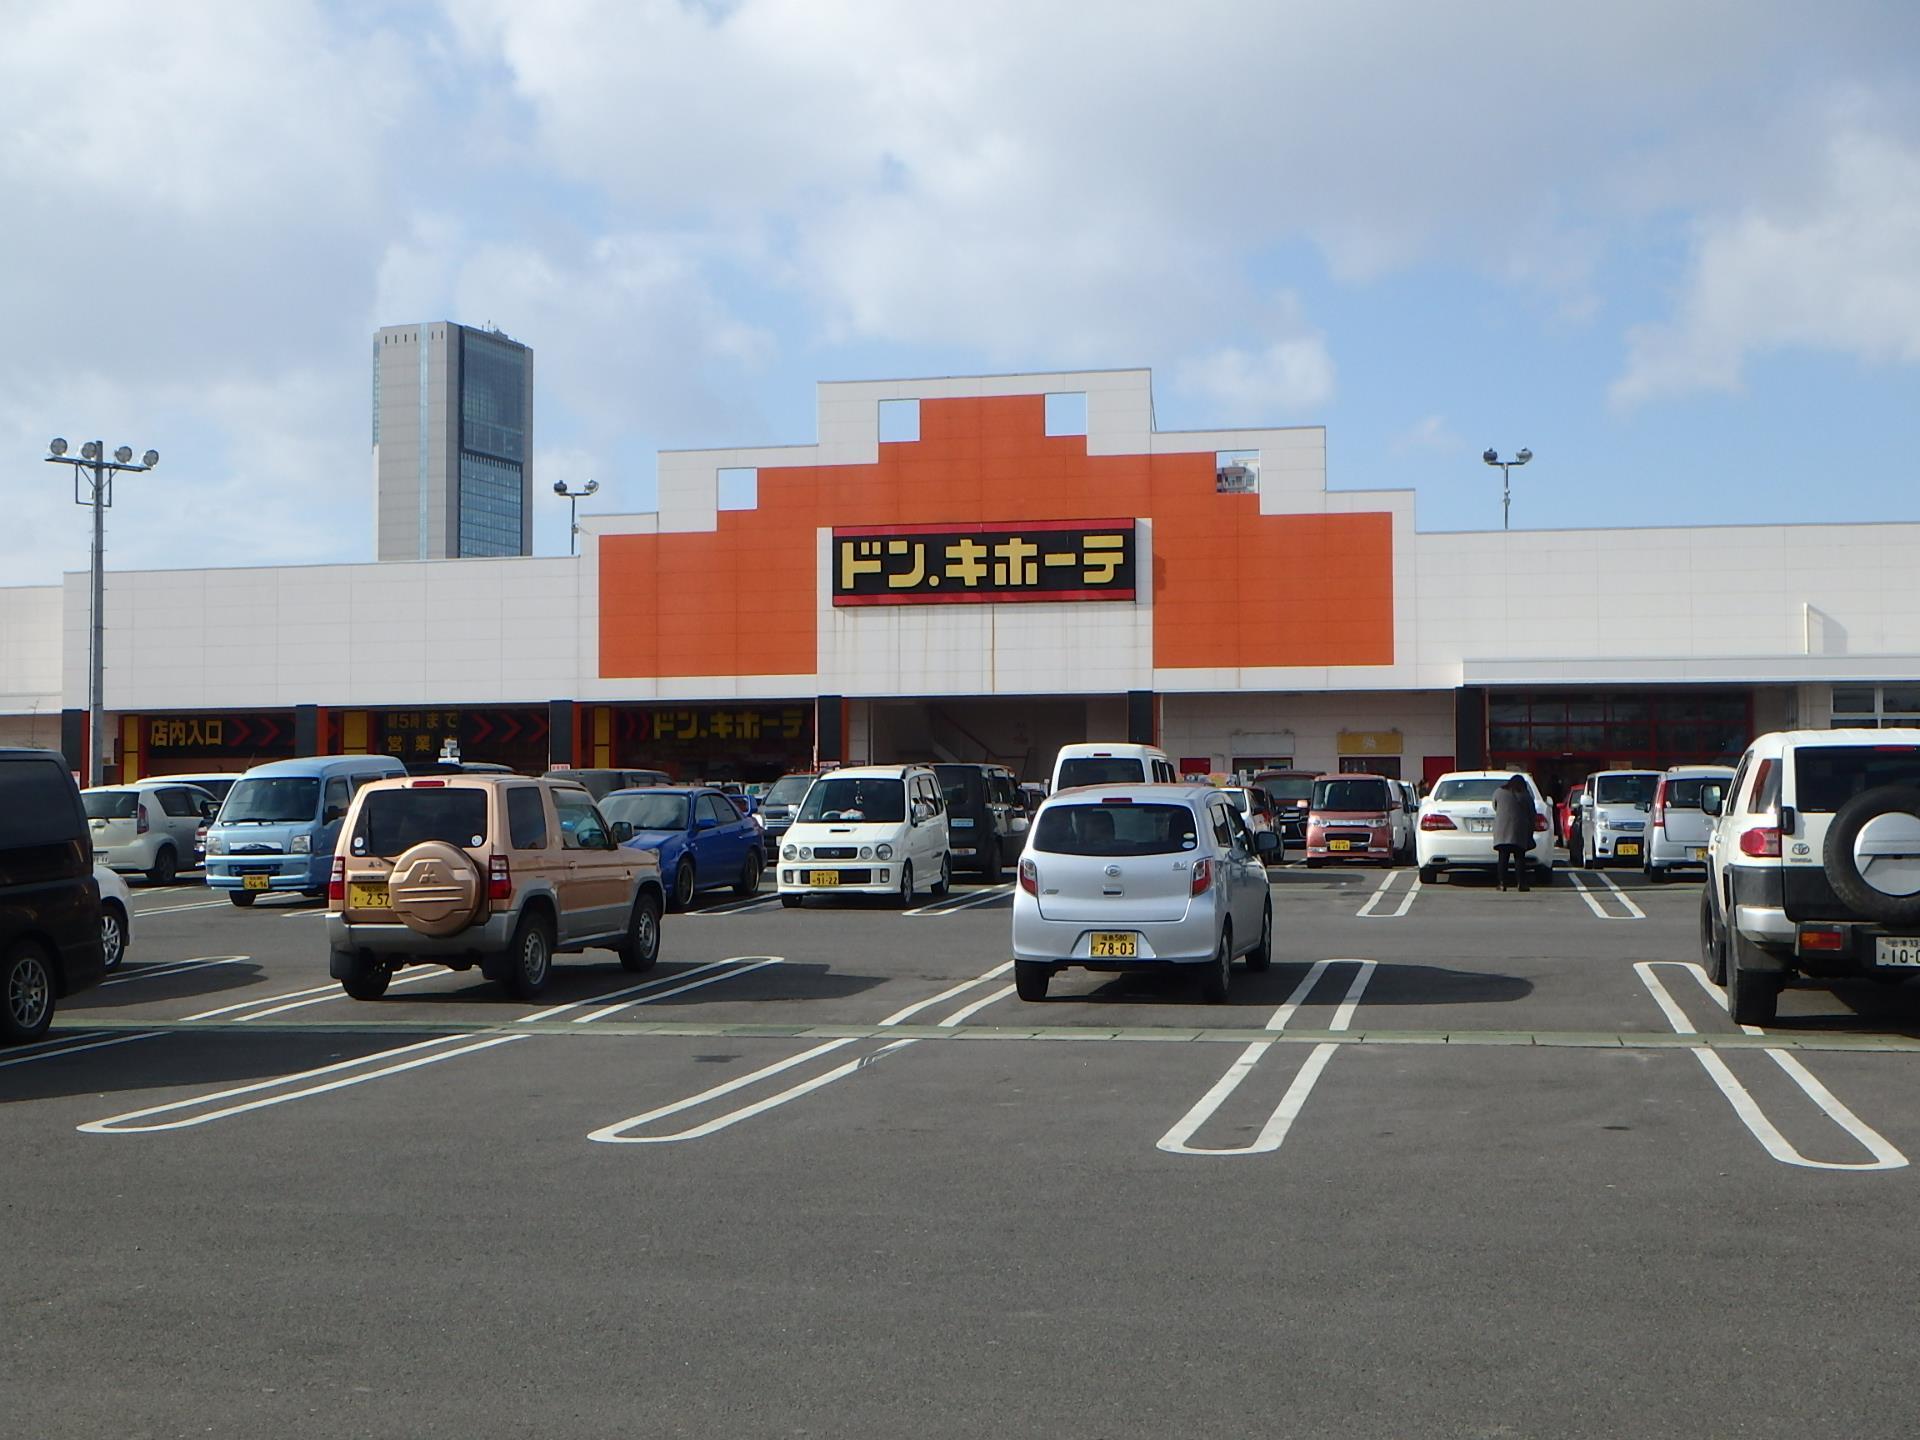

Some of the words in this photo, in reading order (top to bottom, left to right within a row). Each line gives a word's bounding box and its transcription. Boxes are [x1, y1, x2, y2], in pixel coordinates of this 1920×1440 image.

[150, 719, 223, 746] 店内入口
[1099, 942, 1135, 956] 78-03
